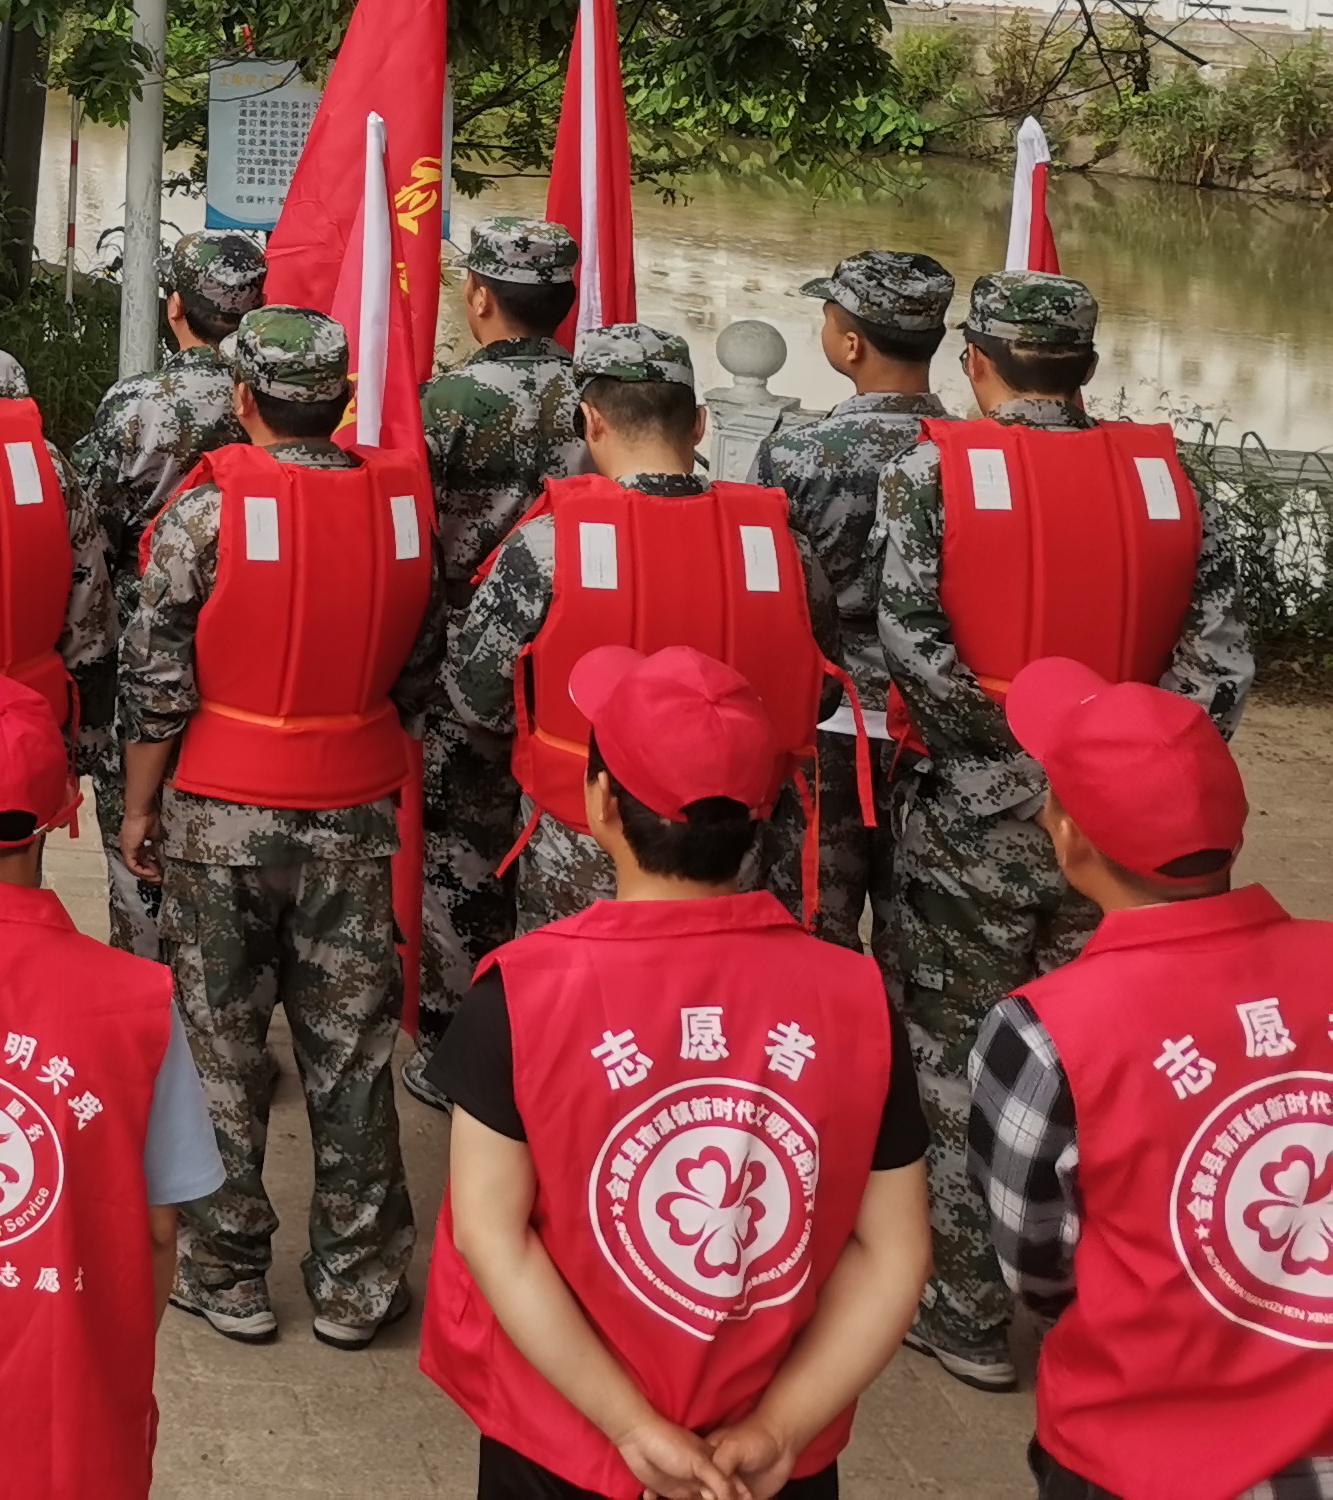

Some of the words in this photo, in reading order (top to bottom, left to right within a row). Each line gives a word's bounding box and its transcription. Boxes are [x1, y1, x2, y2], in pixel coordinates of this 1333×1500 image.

[590, 1006, 816, 1090] 志愿者
[1152, 997, 1333, 1100] 志愿
[3, 1186, 50, 1233] Service
